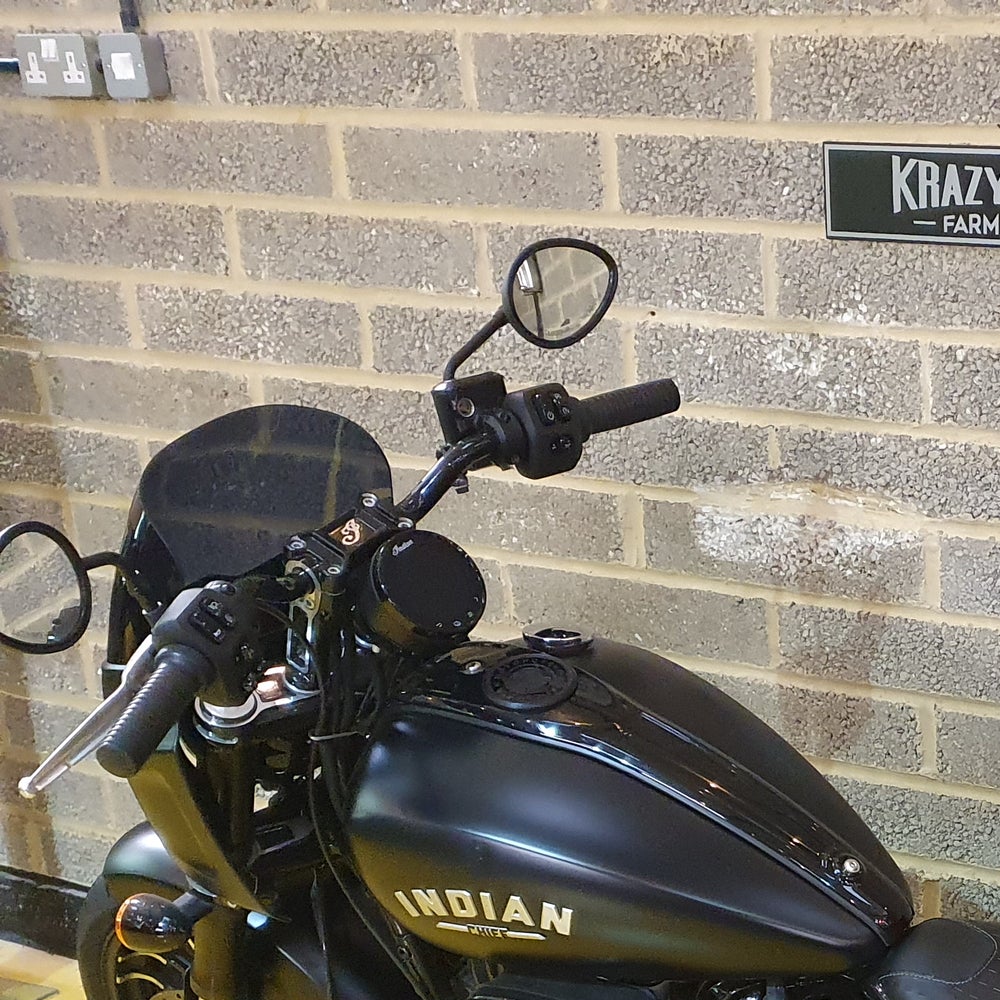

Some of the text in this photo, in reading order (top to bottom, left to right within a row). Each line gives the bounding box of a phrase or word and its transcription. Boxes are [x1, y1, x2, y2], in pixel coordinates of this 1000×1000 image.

[943, 213, 1000, 236] FARM
[394, 889, 574, 936] INDIAN
[467, 924, 508, 938] CHIEF
